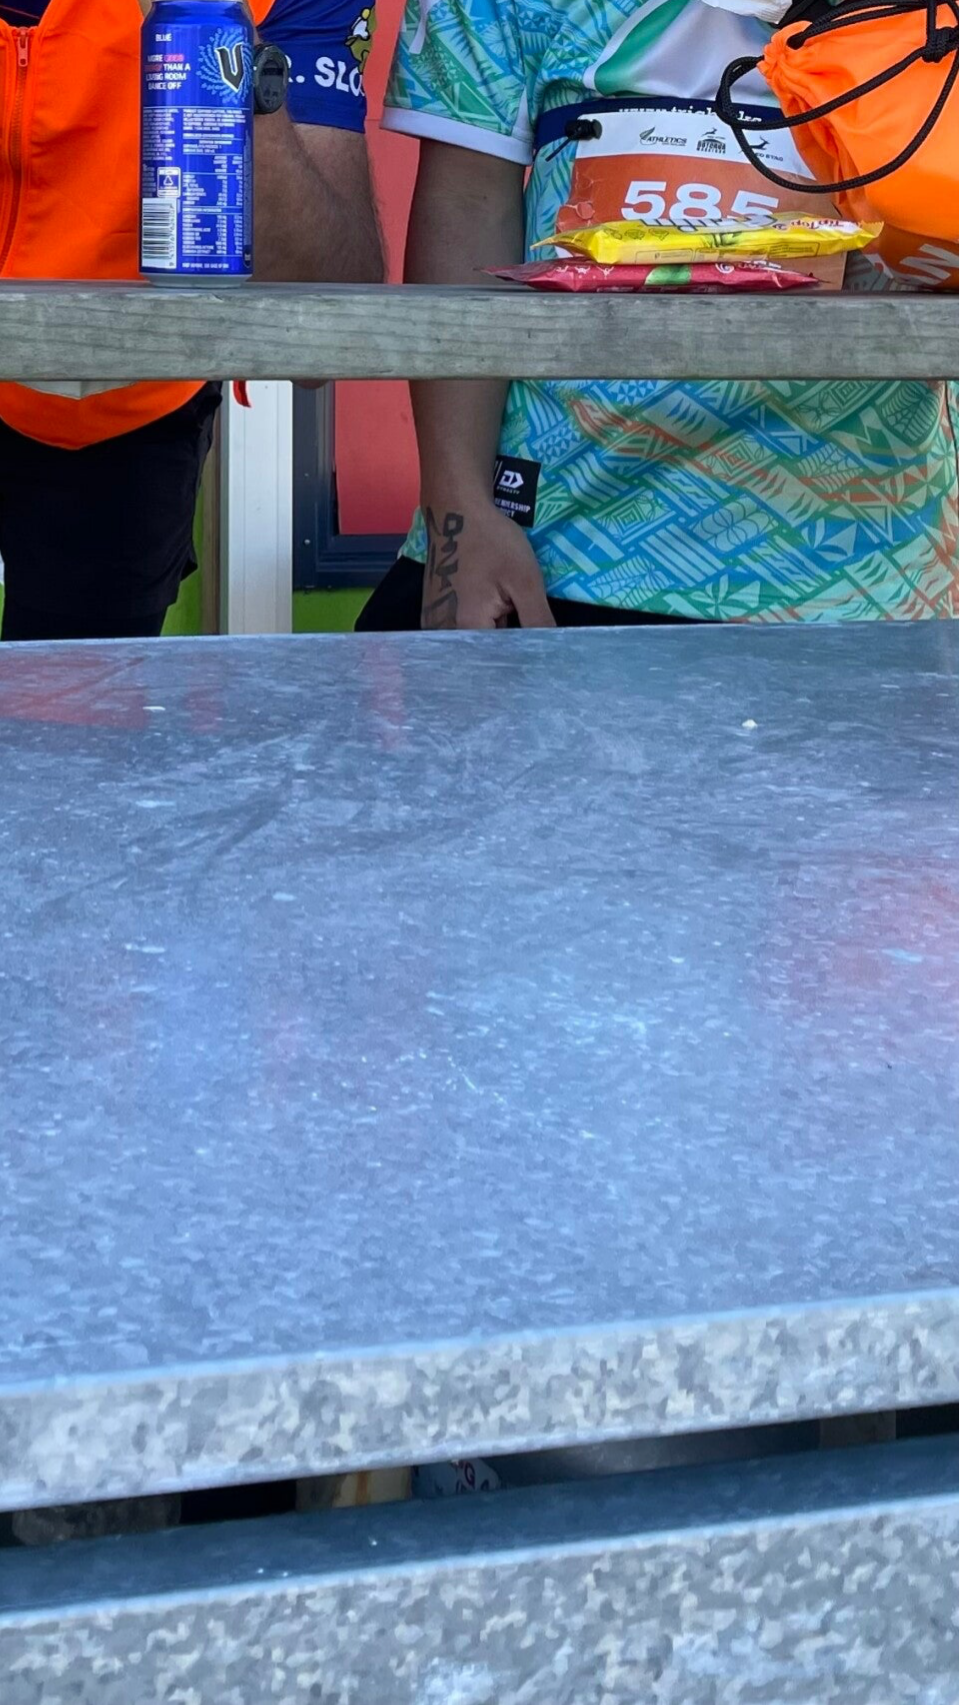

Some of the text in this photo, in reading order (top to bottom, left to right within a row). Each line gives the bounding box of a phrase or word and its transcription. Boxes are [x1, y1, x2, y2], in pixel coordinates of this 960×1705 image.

[163, 63, 183, 71] THAN
[214, 42, 244, 93] V
[621, 180, 780, 221] 585
